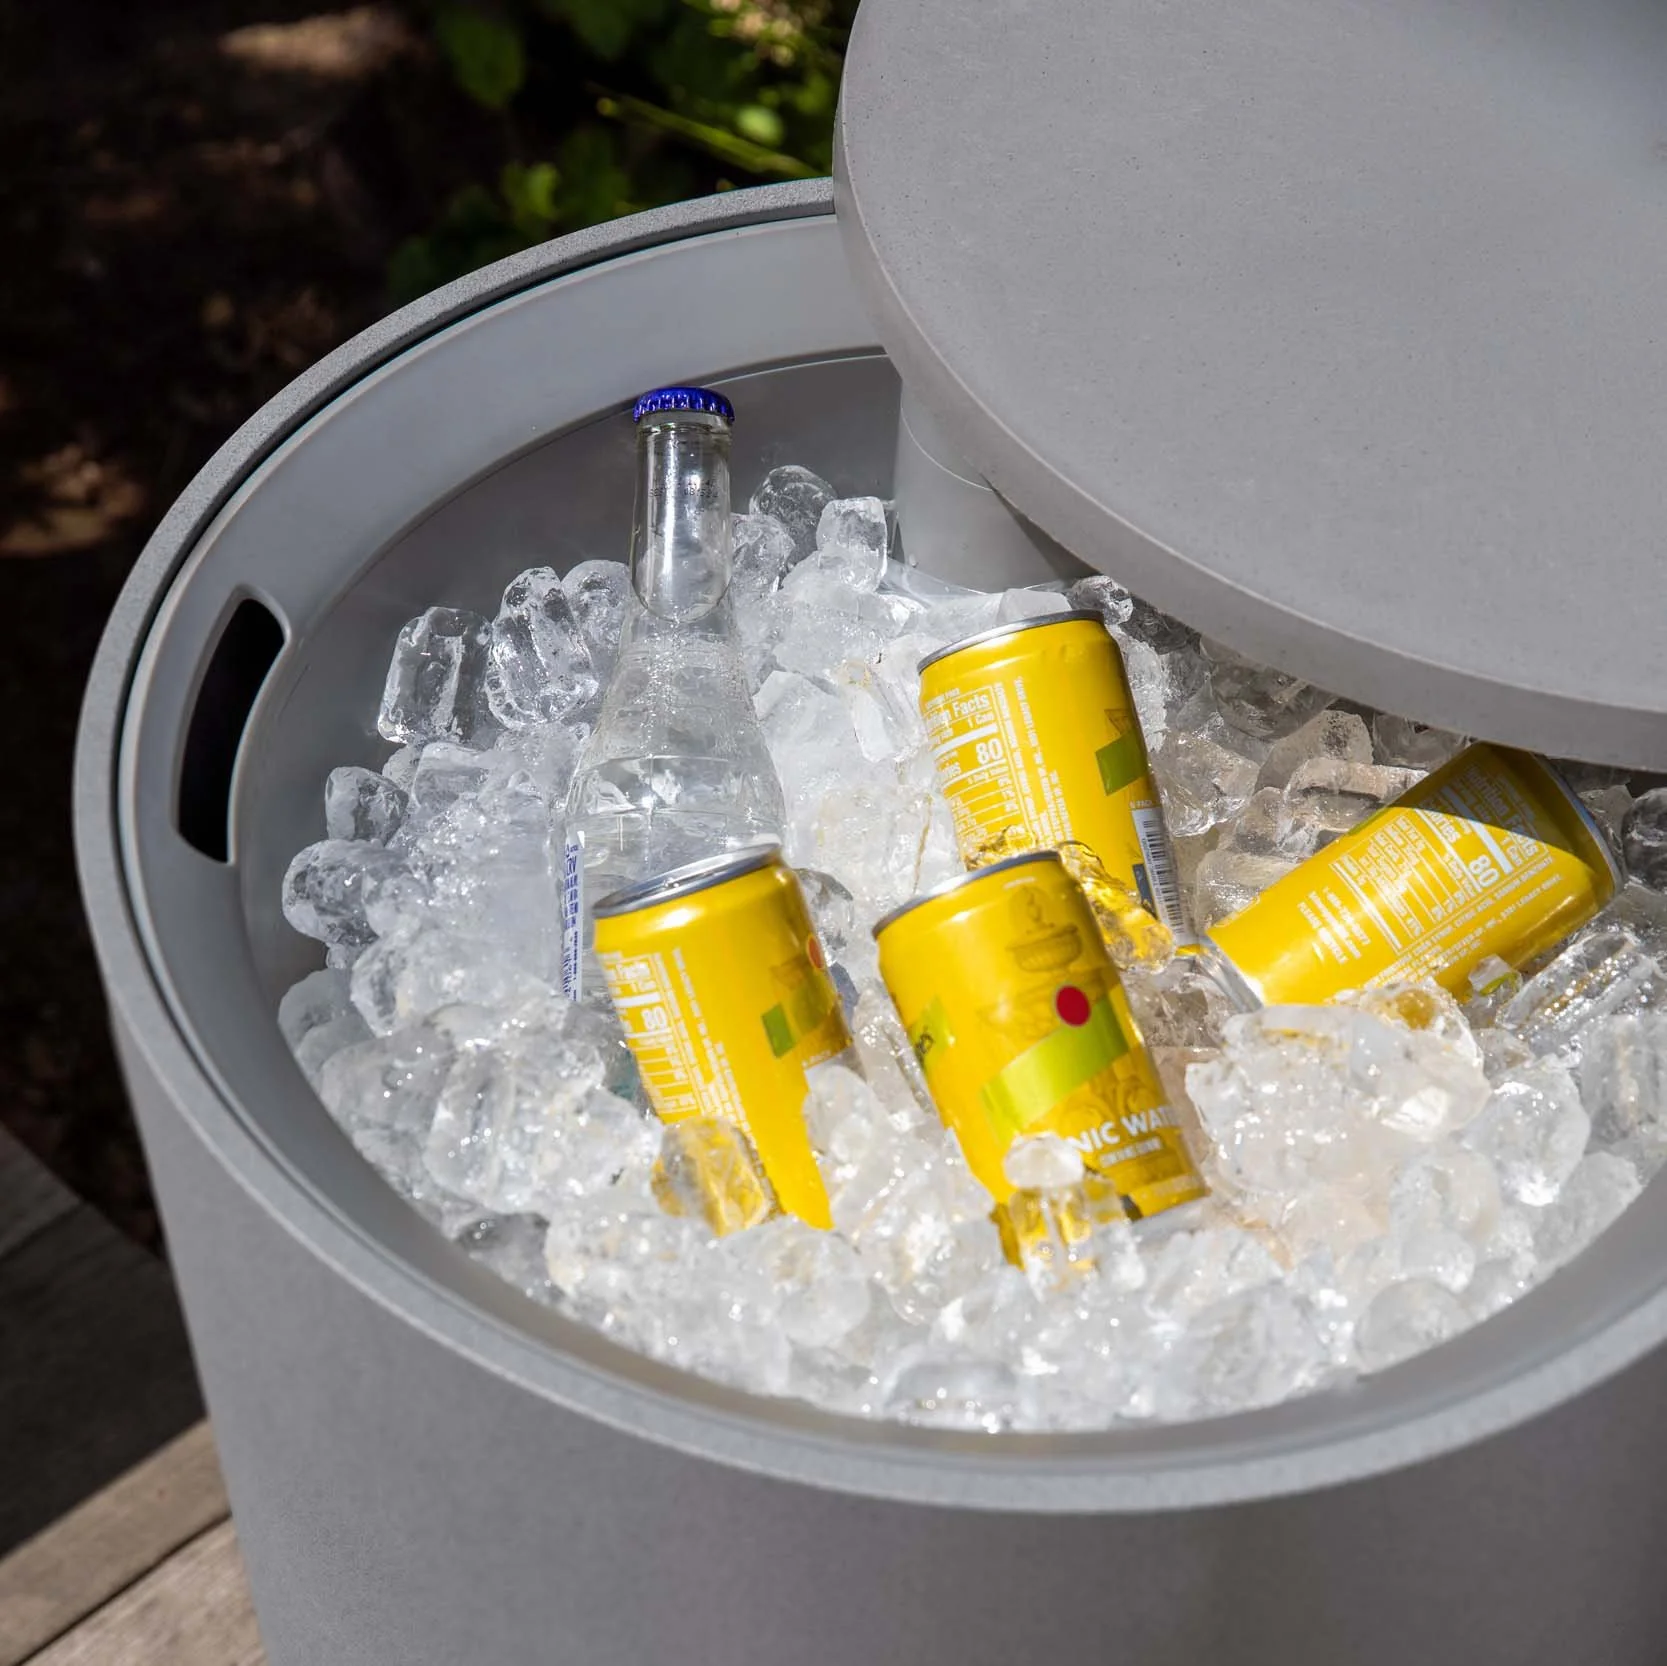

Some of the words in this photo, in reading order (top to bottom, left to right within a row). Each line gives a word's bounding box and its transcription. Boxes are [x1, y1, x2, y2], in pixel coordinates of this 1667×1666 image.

[952, 692, 989, 717] Facts
[974, 737, 1004, 765] 80
[1466, 852, 1501, 889] 80
[1066, 1121, 1120, 1154] NIC
